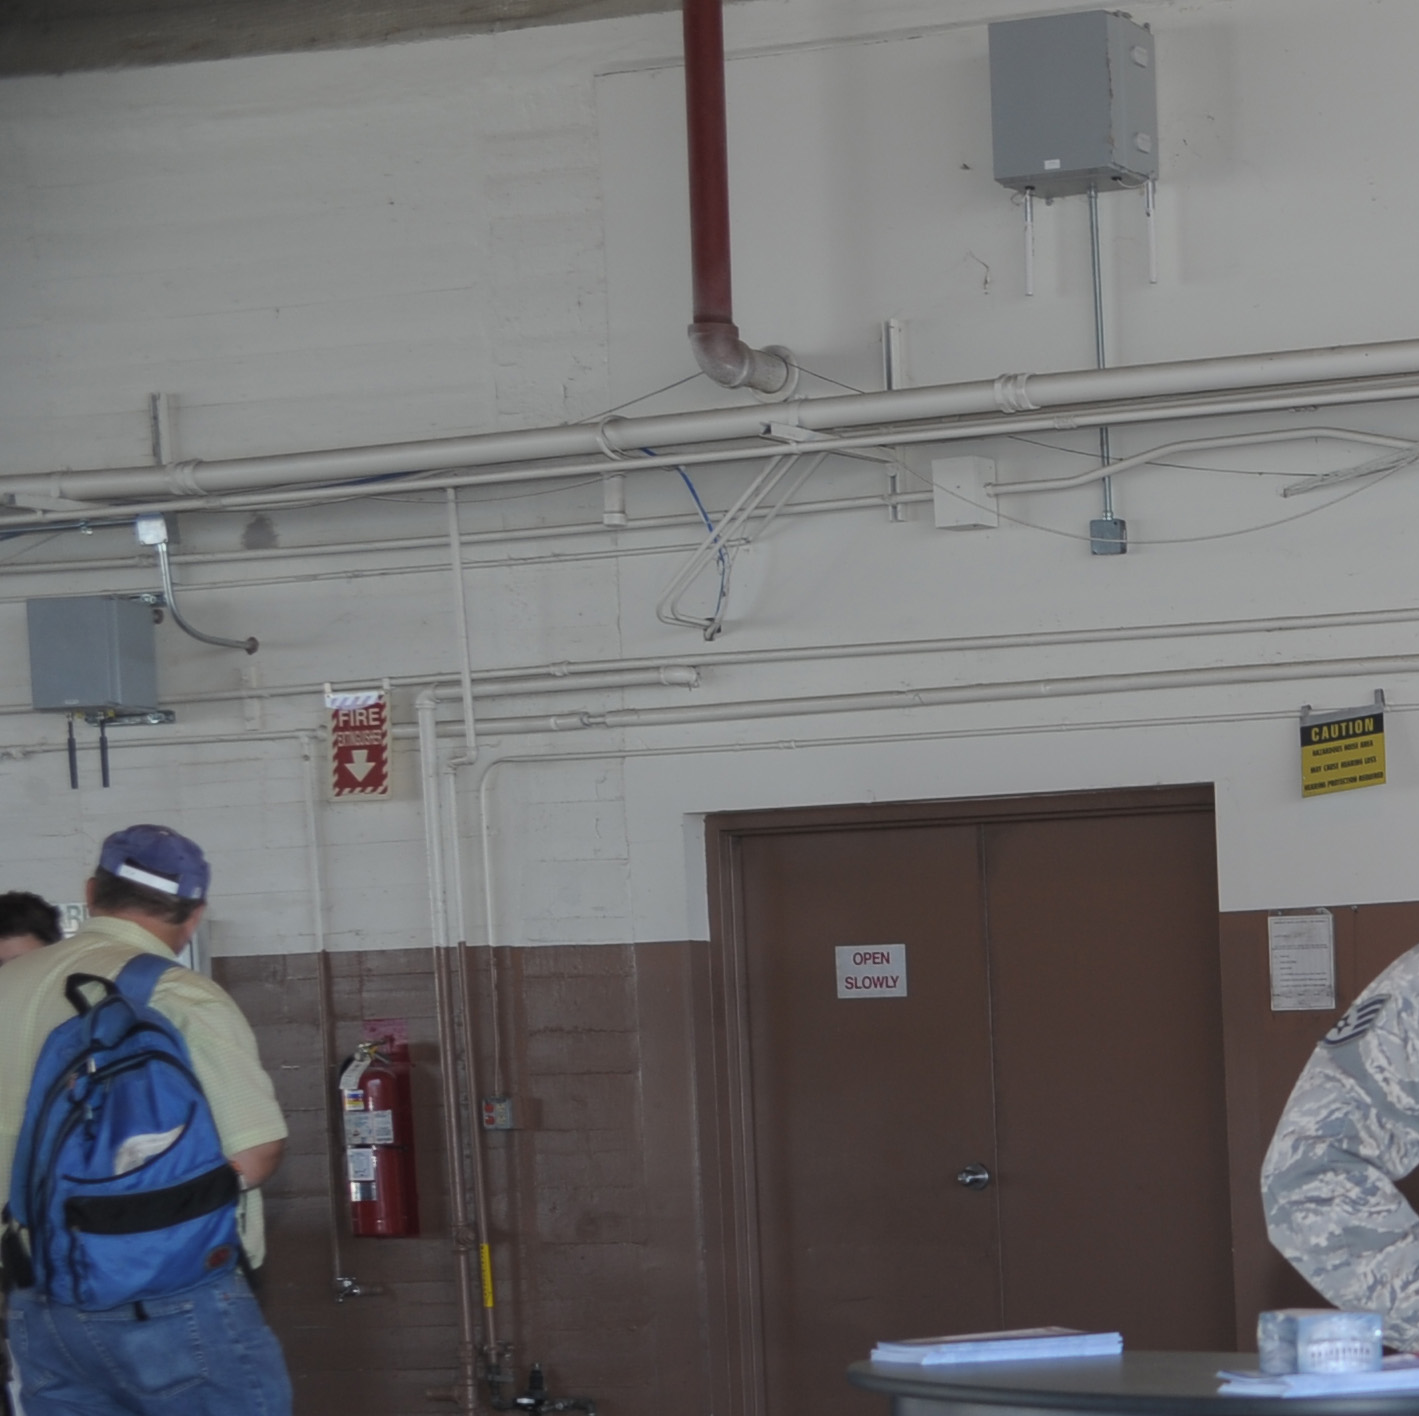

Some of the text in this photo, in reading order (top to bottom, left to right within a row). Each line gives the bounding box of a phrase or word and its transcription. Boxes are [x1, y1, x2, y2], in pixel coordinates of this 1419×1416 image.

[338, 707, 382, 728] FIRE
[1311, 717, 1374, 742] CAUTION
[853, 951, 890, 966] OPEN
[844, 975, 900, 990] SLOWLY
